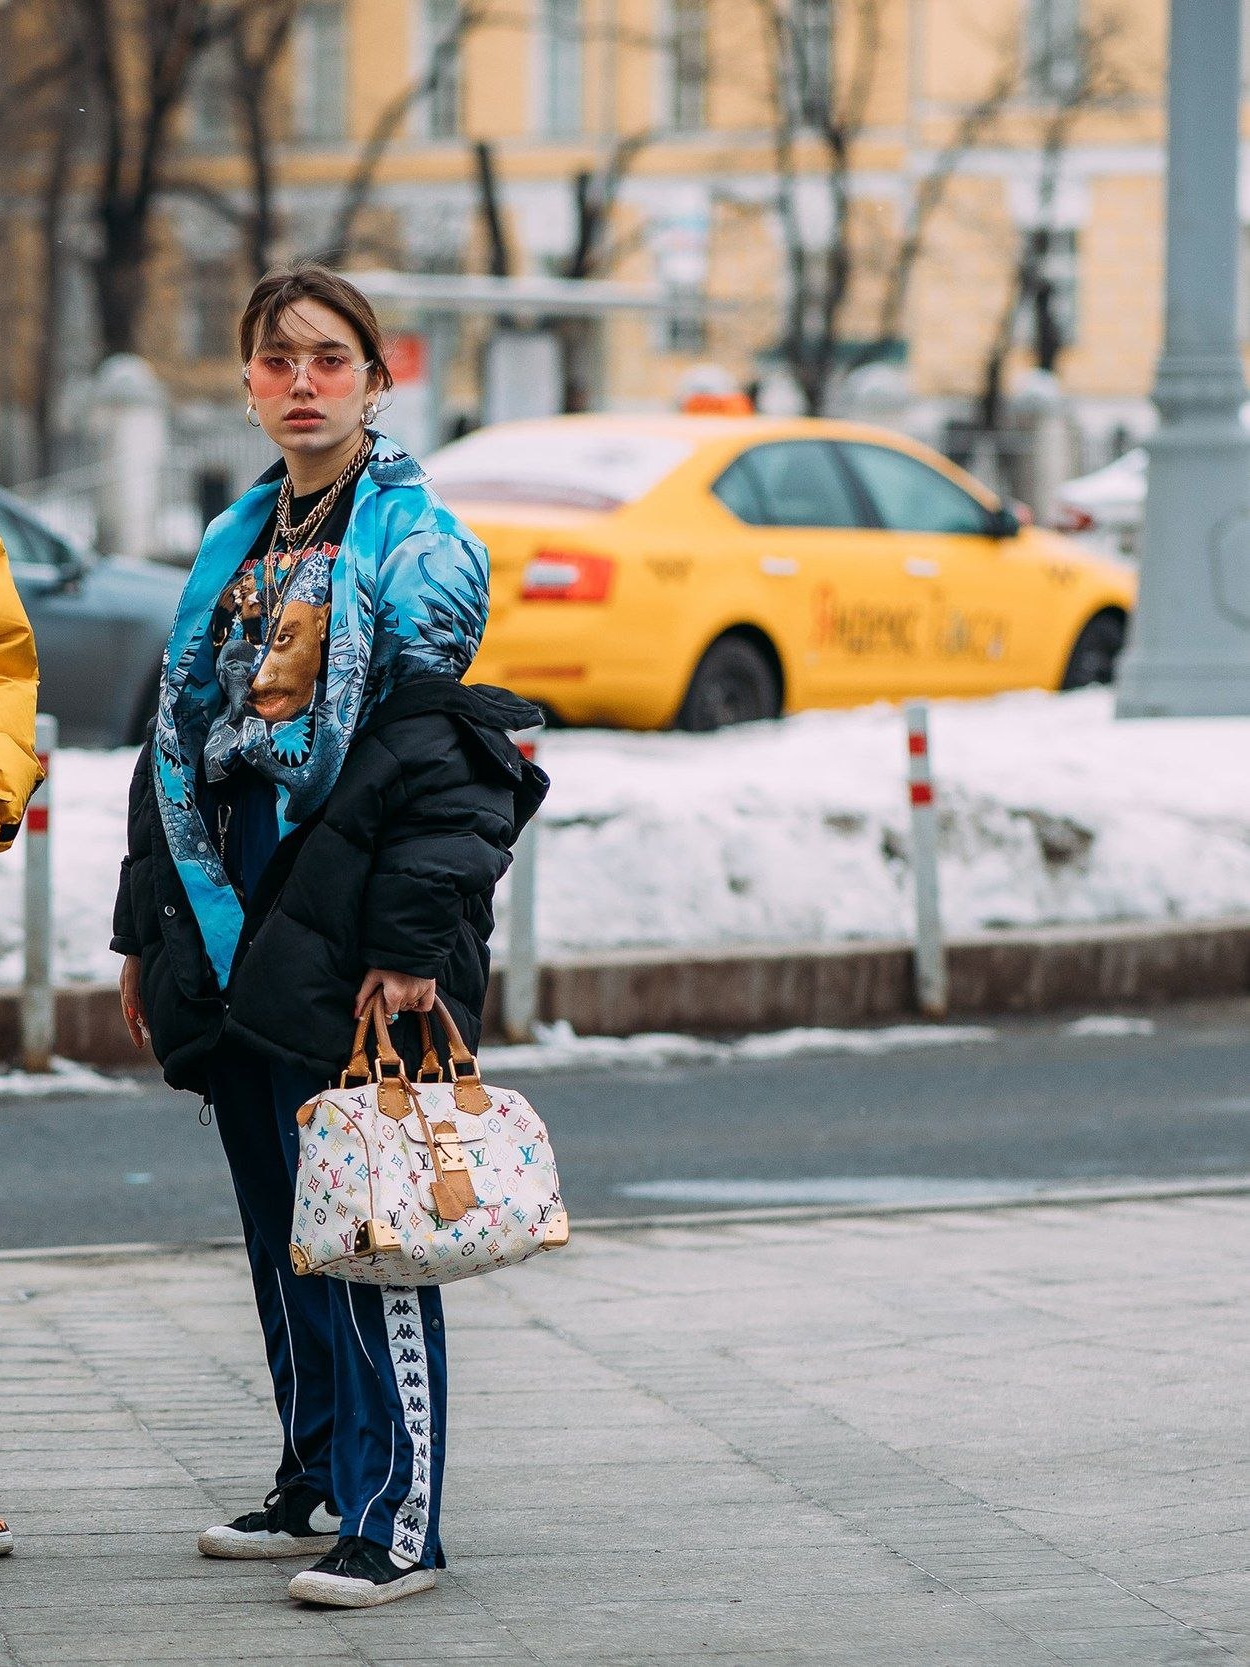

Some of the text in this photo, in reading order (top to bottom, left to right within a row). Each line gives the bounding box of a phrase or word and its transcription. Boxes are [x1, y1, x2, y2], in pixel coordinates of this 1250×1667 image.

[469, 1147, 490, 1168] LV
[518, 1143, 540, 1165] LV
[329, 1166, 345, 1190] LV
[482, 1205, 503, 1227] LV
